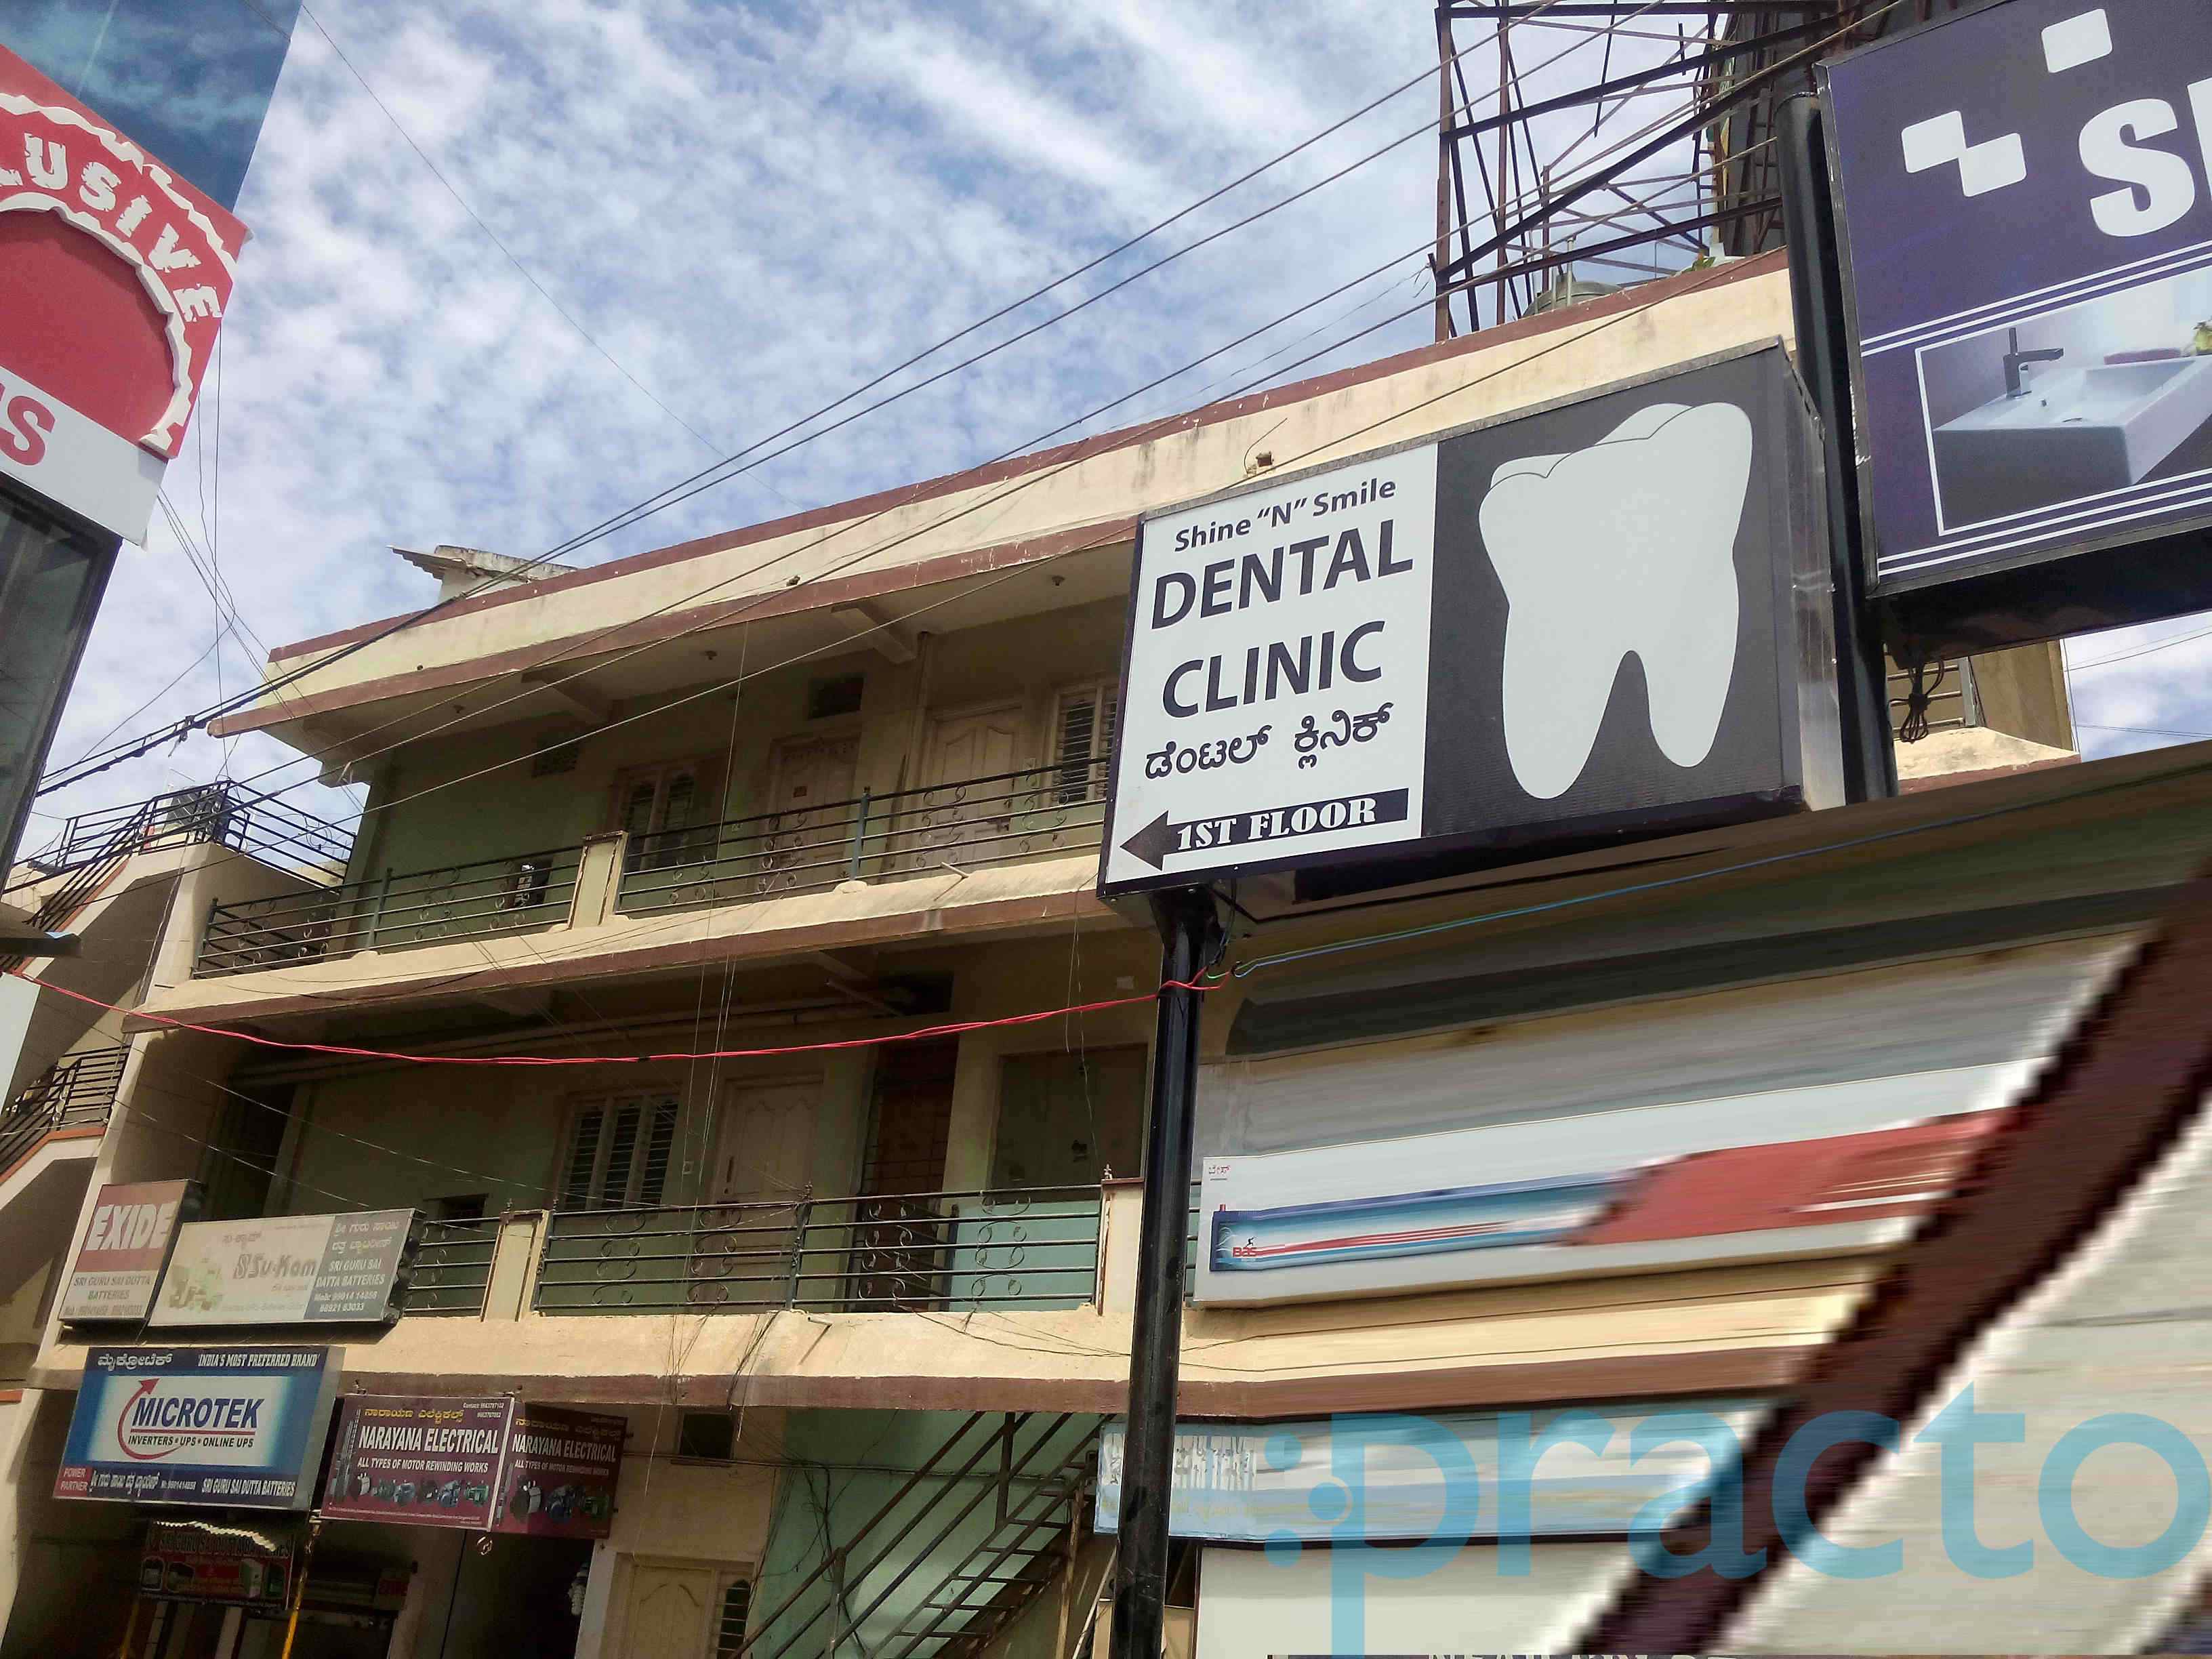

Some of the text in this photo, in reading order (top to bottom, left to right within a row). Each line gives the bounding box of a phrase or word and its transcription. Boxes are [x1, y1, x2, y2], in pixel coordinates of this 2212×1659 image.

[0, 381, 55, 466] S
[1174, 519, 1251, 552] Shine
[1313, 478, 1396, 517] Smile
[1151, 519, 1414, 629] DENTAL
[1162, 621, 1385, 718] CLINIC
[1145, 702, 1394, 779] ಡೆಂಟಲ್ ಕ್ಲಿನಿಕ್
[1177, 798, 1376, 851] 1ST FLOOR
[85, 1202, 176, 1250] EXIDE
[329, 1258, 382, 1272] SRI GURU SAI
[73, 1277, 87, 1286] SRI
[88, 1276, 109, 1286] GURU
[341, 1274, 386, 1287] BATTERIES
[87, 1290, 130, 1300] BATTERIES
[226, 1354, 245, 1367] MOST
[247, 1354, 289, 1367] PREFERRED
[132, 1397, 265, 1428] MICROTEK
[128, 1435, 254, 1448] INVERTERS UPS ONLINE UPS
[359, 1426, 499, 1454] NARAYANA ELECTRICAL
[512, 1433, 561, 1457] NARAYANA
[563, 1439, 617, 1462] ELECTRICAL
[64, 1468, 87, 1478] POWER
[358, 1457, 489, 1473] ALL TYPES OF MOTOR REWINDING WORKS
[60, 1481, 88, 1492] PARTNER
[202, 1477, 213, 1492] SRI
[213, 1479, 231, 1494] GURU
[230, 1479, 242, 1494] SAI
[262, 1480, 296, 1497] BATTERIES
